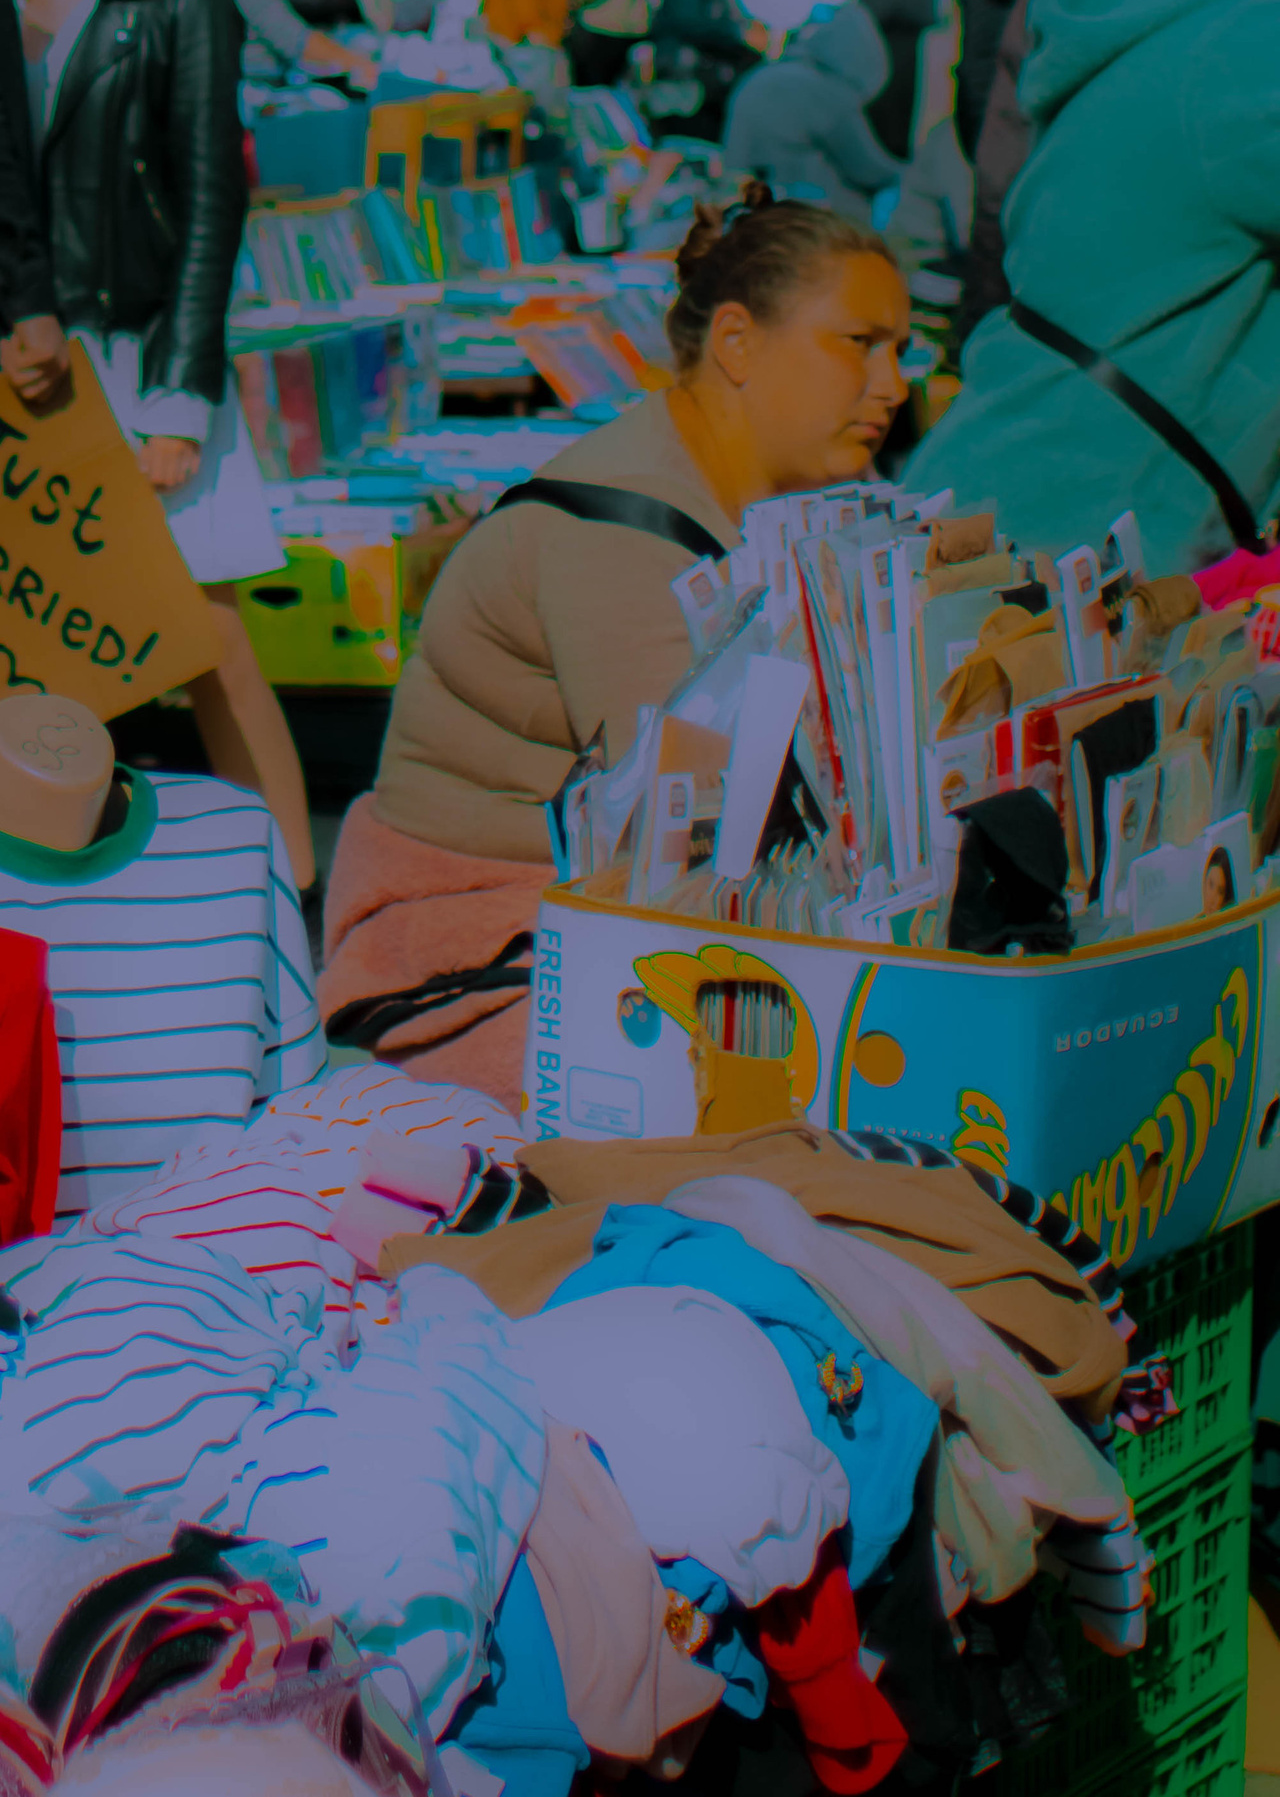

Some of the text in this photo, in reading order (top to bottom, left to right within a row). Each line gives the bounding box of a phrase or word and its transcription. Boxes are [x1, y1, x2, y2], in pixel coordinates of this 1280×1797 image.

[538, 928, 562, 1038] FRESH
[1055, 1005, 1180, 1054] ECUADOR
[864, 1124, 946, 1142] ECUADOR
